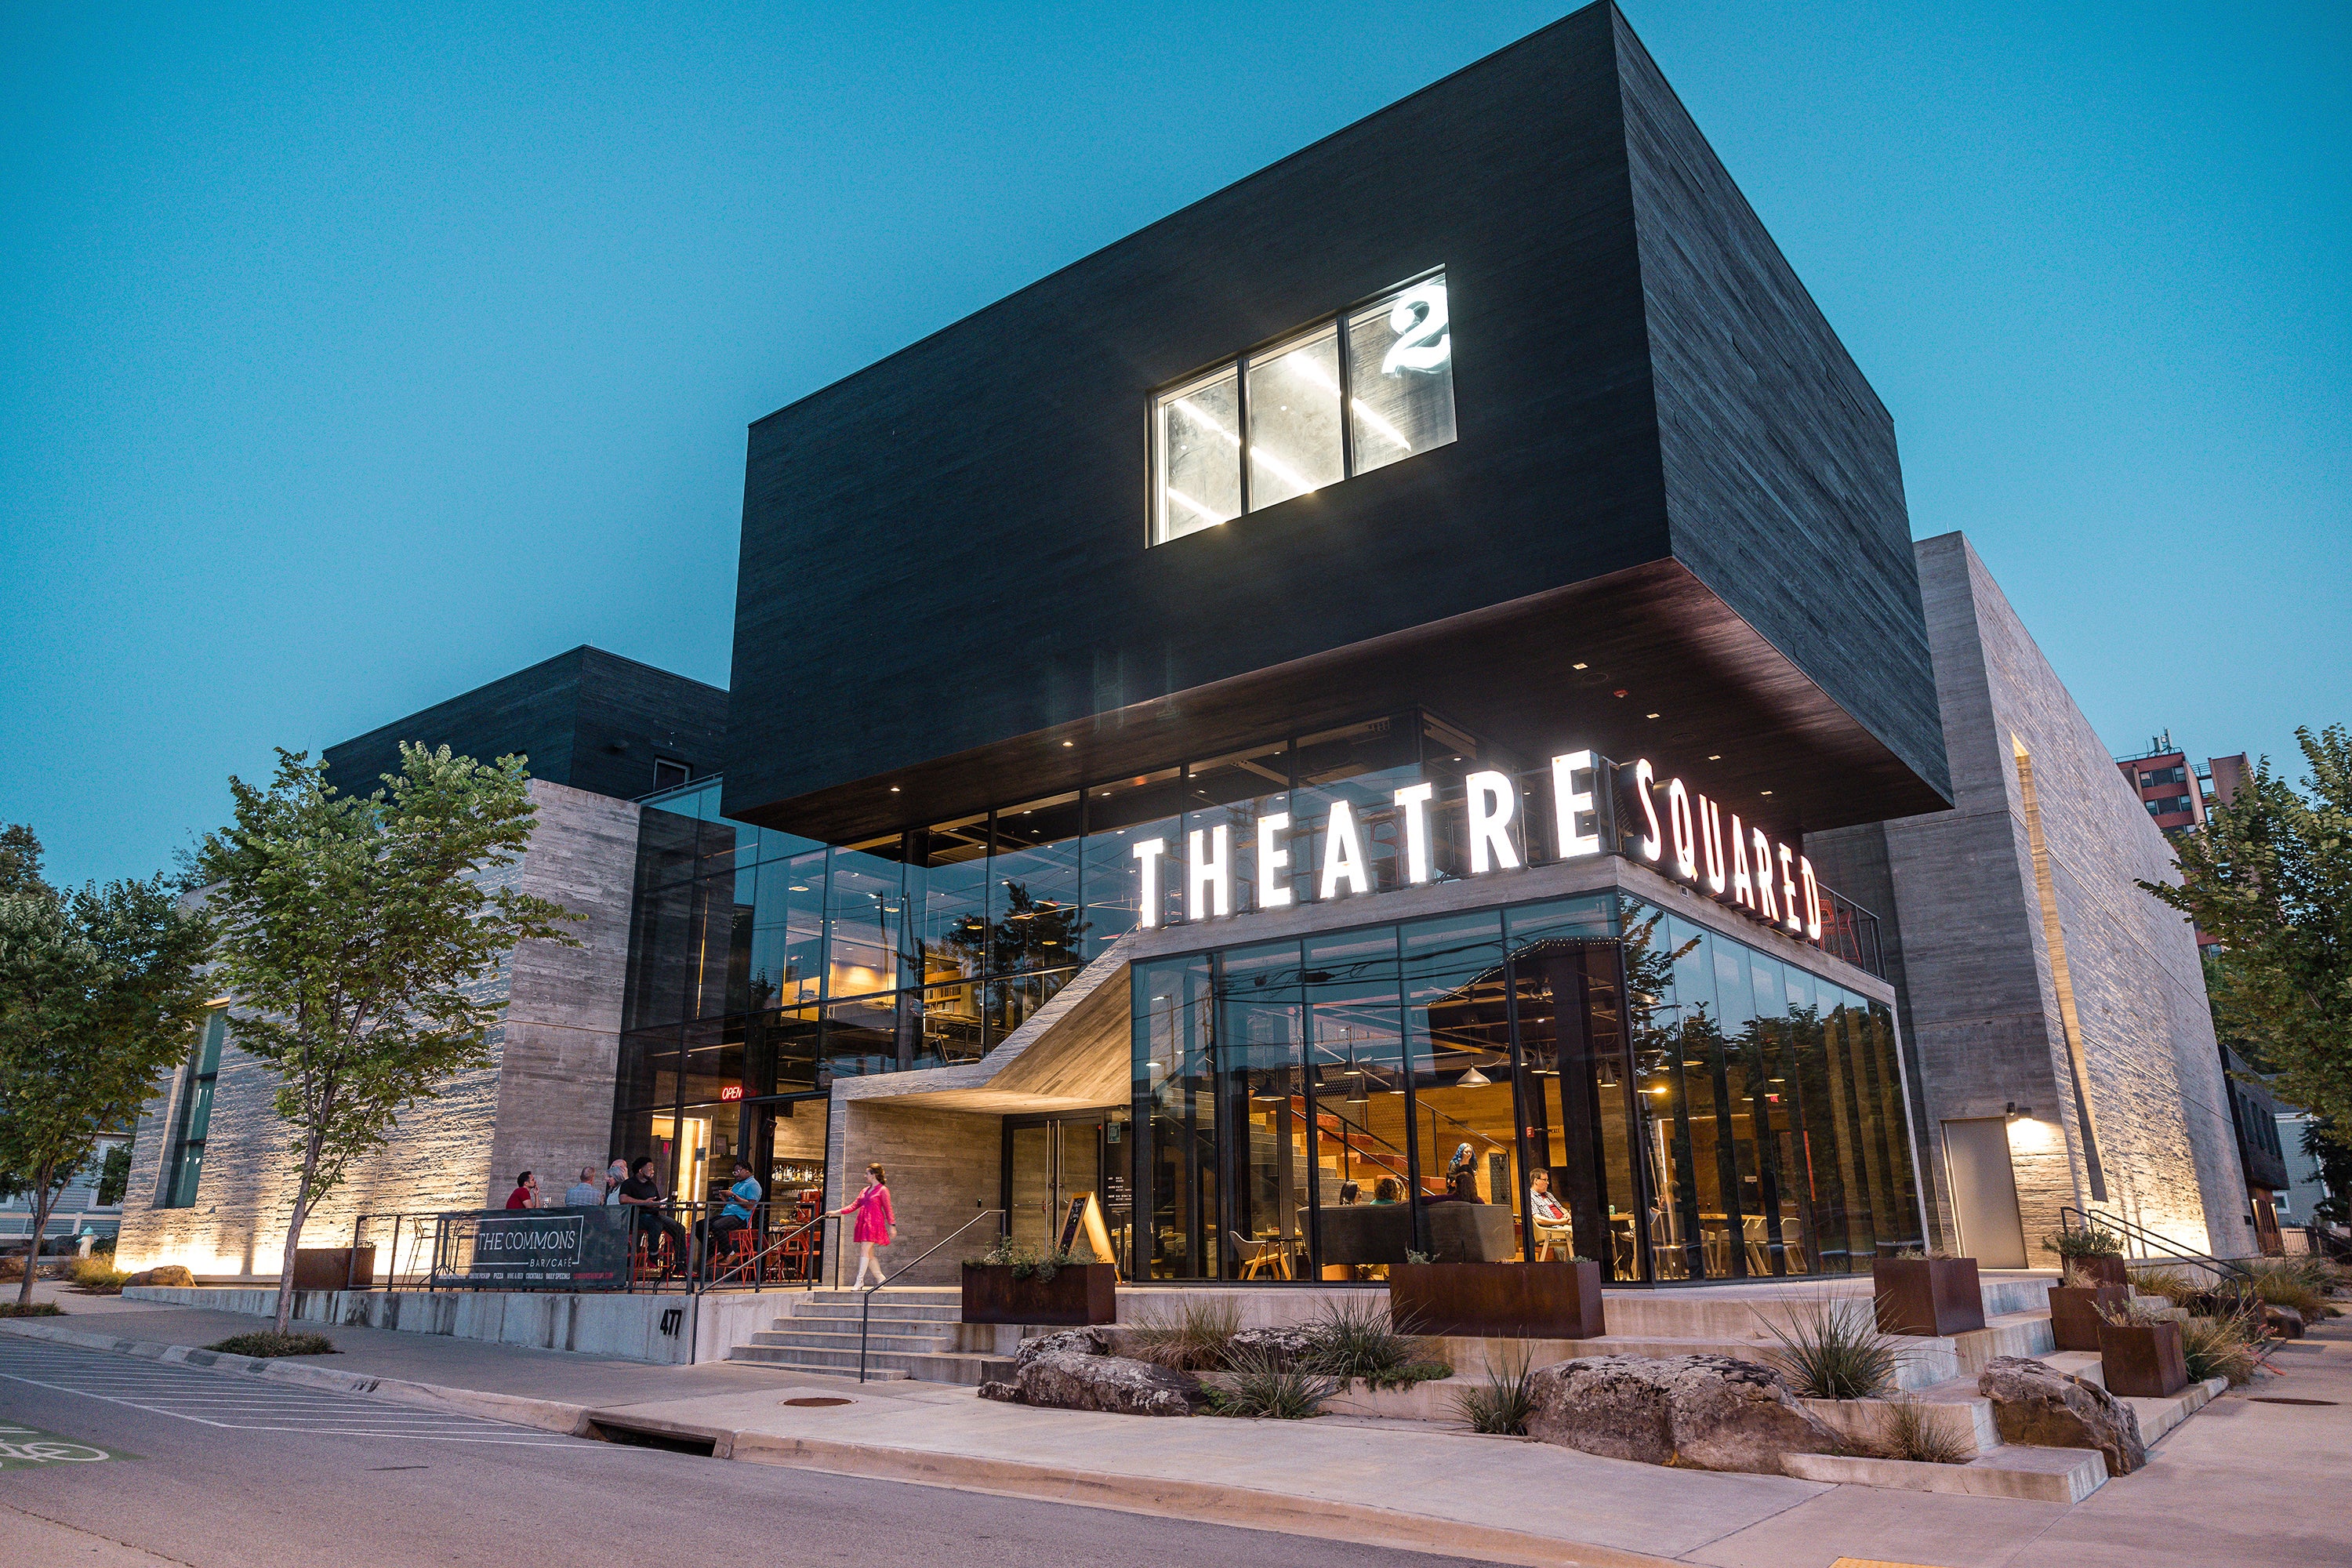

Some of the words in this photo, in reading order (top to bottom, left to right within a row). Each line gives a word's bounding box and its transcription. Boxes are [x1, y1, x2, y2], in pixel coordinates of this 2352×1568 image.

[1381, 284, 1451, 376] 2
[1132, 749, 1601, 928] THEATRE
[1635, 757, 1823, 941] SQUARED
[721, 1087, 742, 1100] OPEN
[478, 1232, 503, 1250] THE
[505, 1230, 575, 1250] COMMONS
[529, 1257, 572, 1268] BAR/CAFÉ
[659, 1308, 682, 1336] 477
